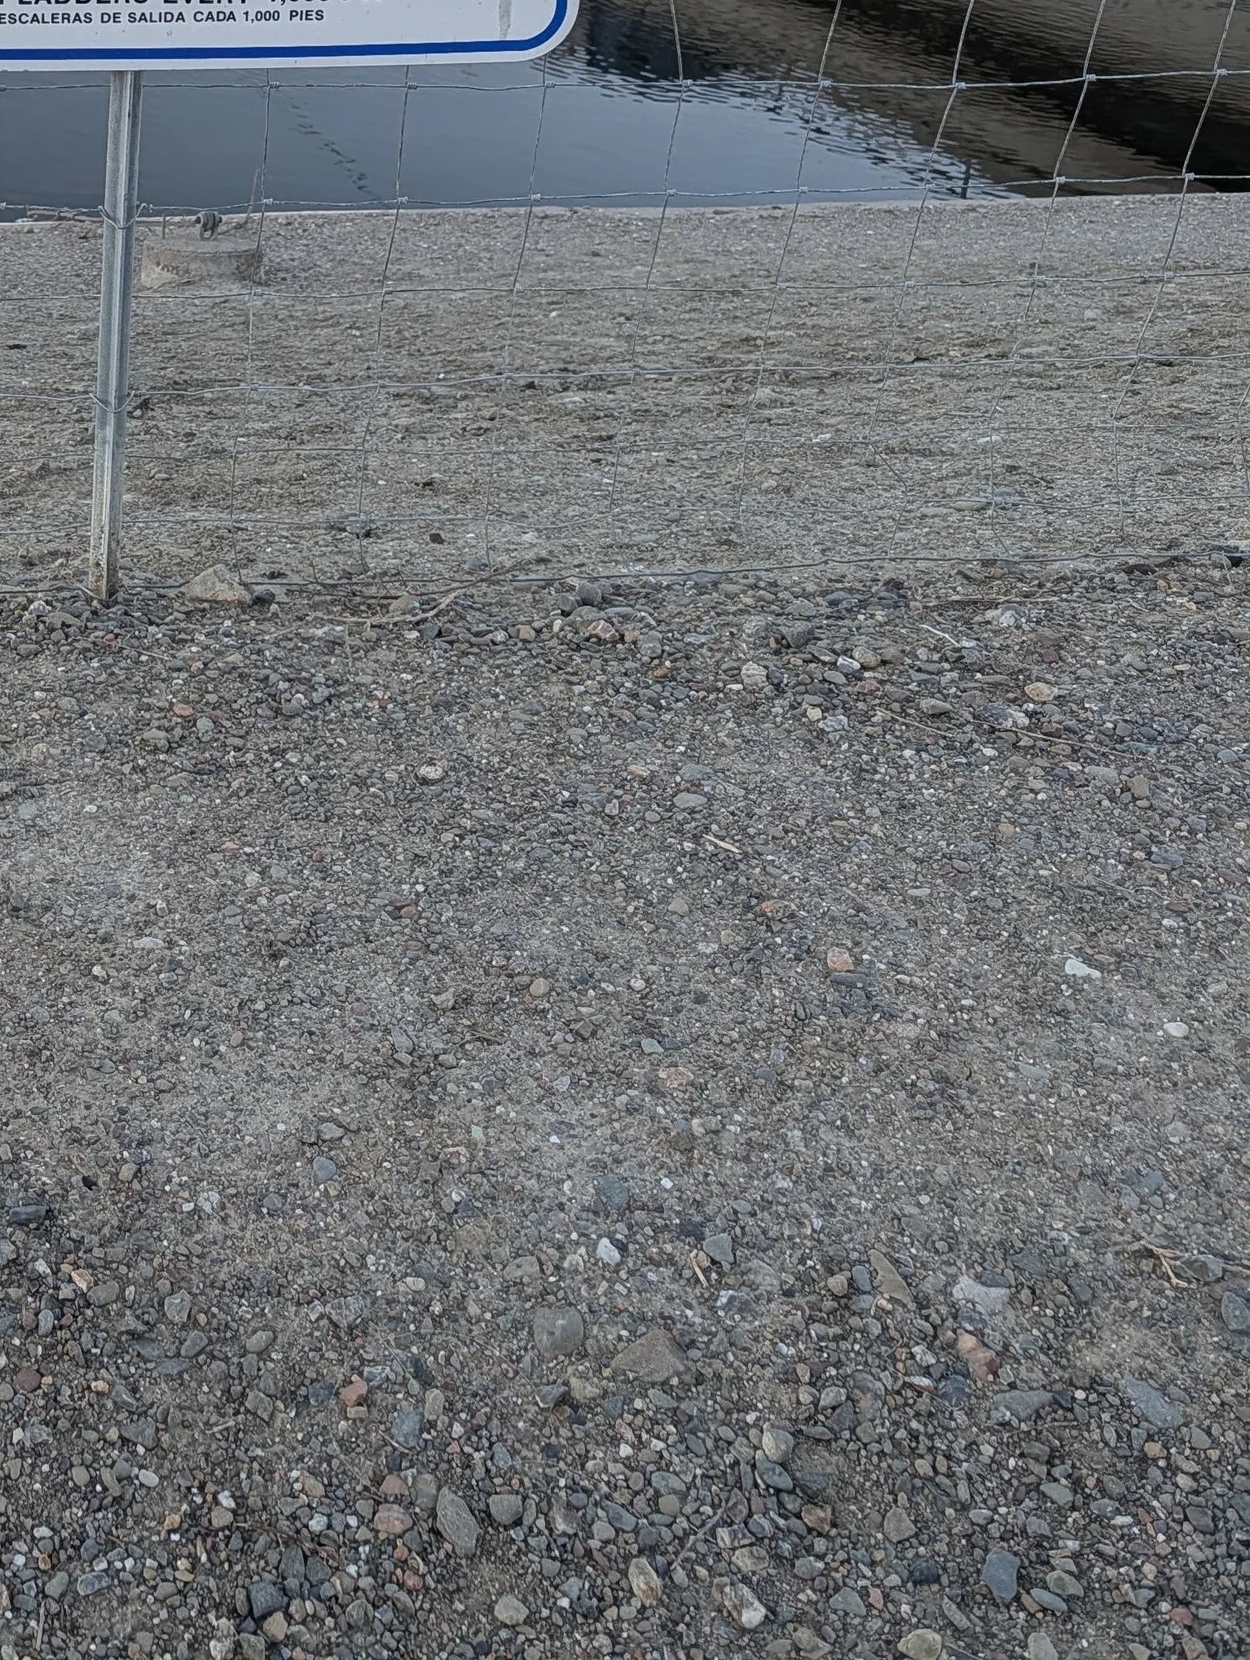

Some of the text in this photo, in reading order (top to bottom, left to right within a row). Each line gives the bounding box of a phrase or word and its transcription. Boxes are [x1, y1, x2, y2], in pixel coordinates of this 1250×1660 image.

[100, 11, 122, 24] DE
[127, 11, 186, 24] SALIDA
[193, 10, 237, 23] CADA
[242, 9, 281, 24] 1,000
[289, 9, 325, 22] PIES
